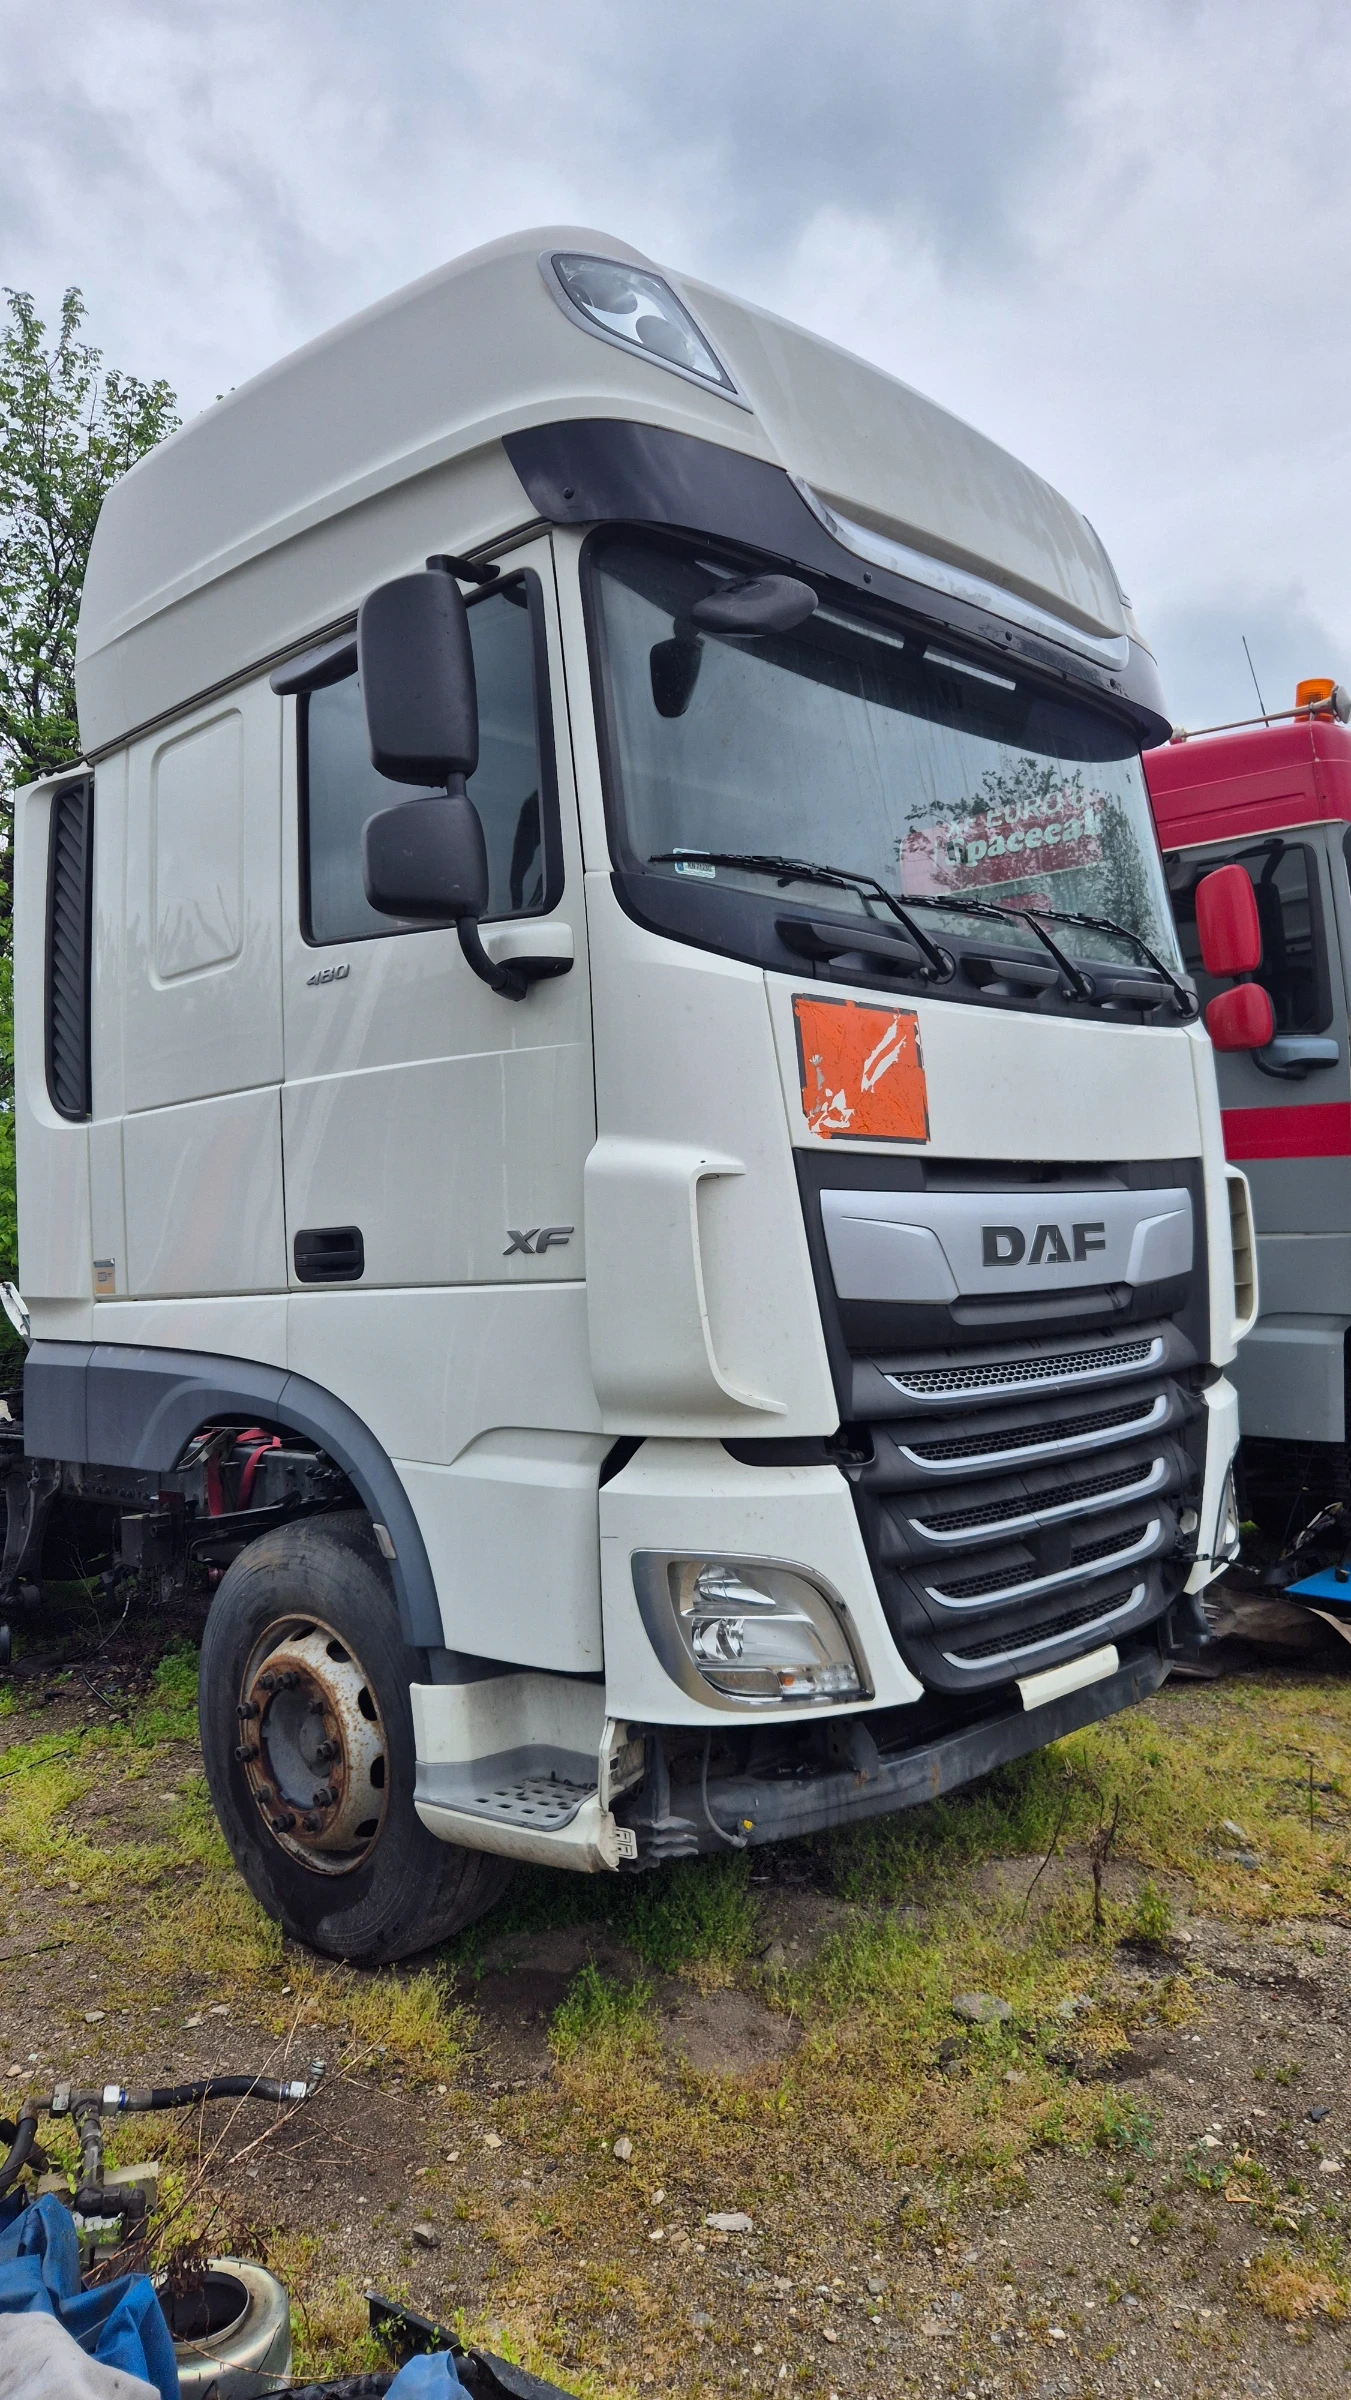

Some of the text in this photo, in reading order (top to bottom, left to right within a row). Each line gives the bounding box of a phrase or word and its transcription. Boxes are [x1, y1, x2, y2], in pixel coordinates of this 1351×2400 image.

[985, 790, 1064, 829] EURO
[306, 963, 351, 986] 480
[502, 1225, 575, 1255] XF
[980, 1221, 1106, 1267] DAF
